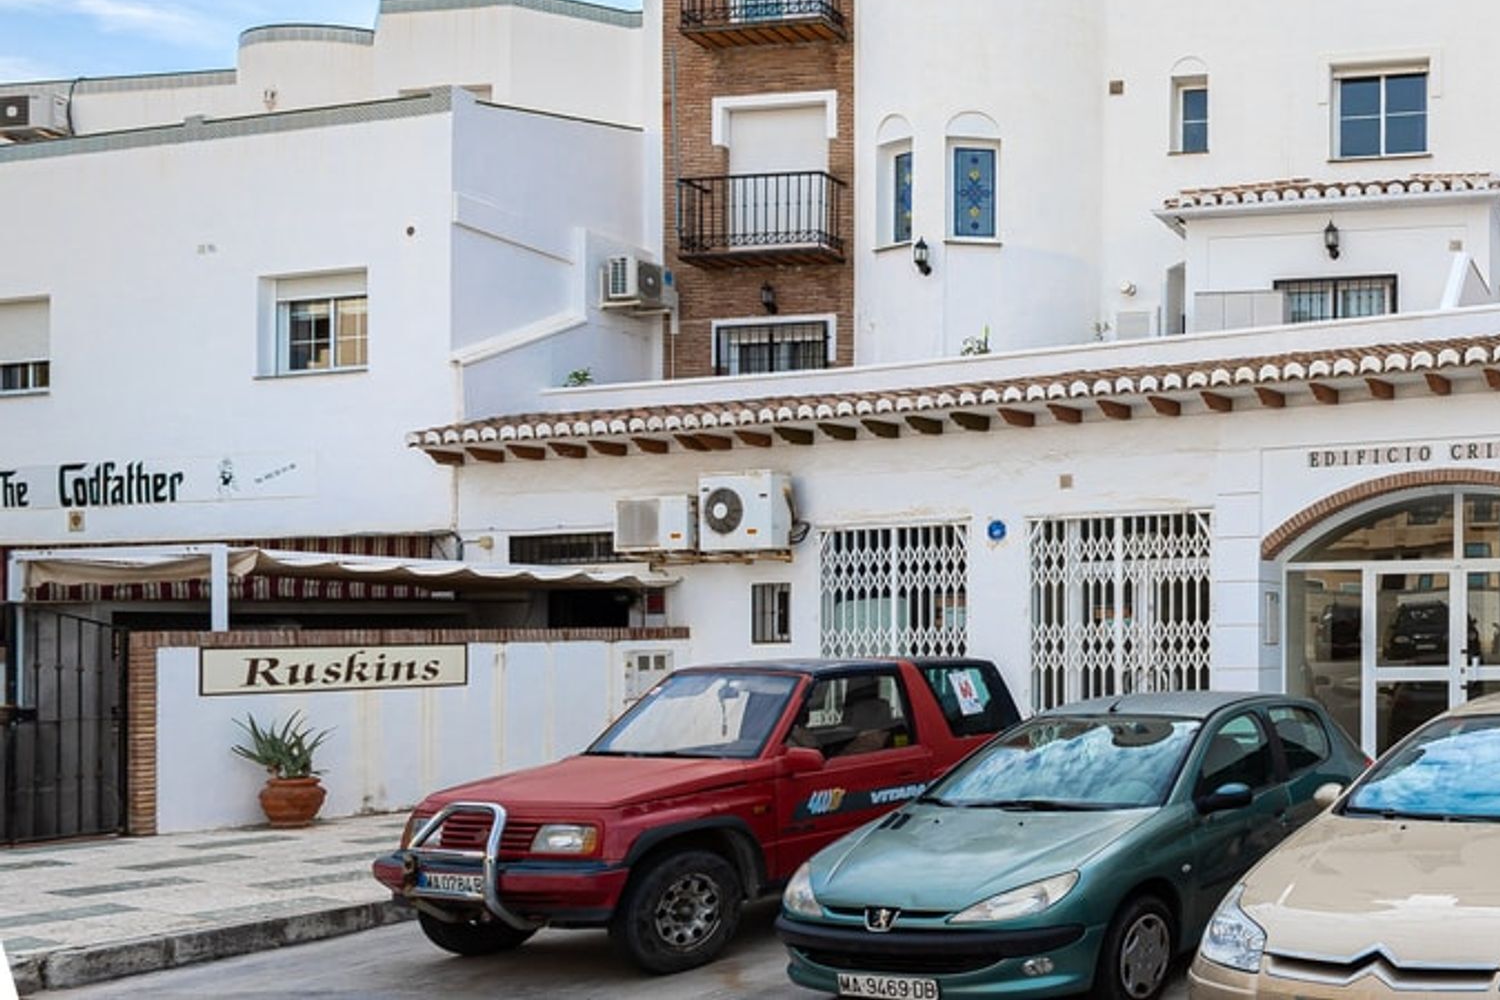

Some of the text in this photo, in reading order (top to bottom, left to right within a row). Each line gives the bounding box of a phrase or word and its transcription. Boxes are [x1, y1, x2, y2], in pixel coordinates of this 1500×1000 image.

[1309, 446, 1432, 468] EDIFICIO
[59, 461, 184, 508] Codfather
[239, 651, 441, 688] Ruskins
